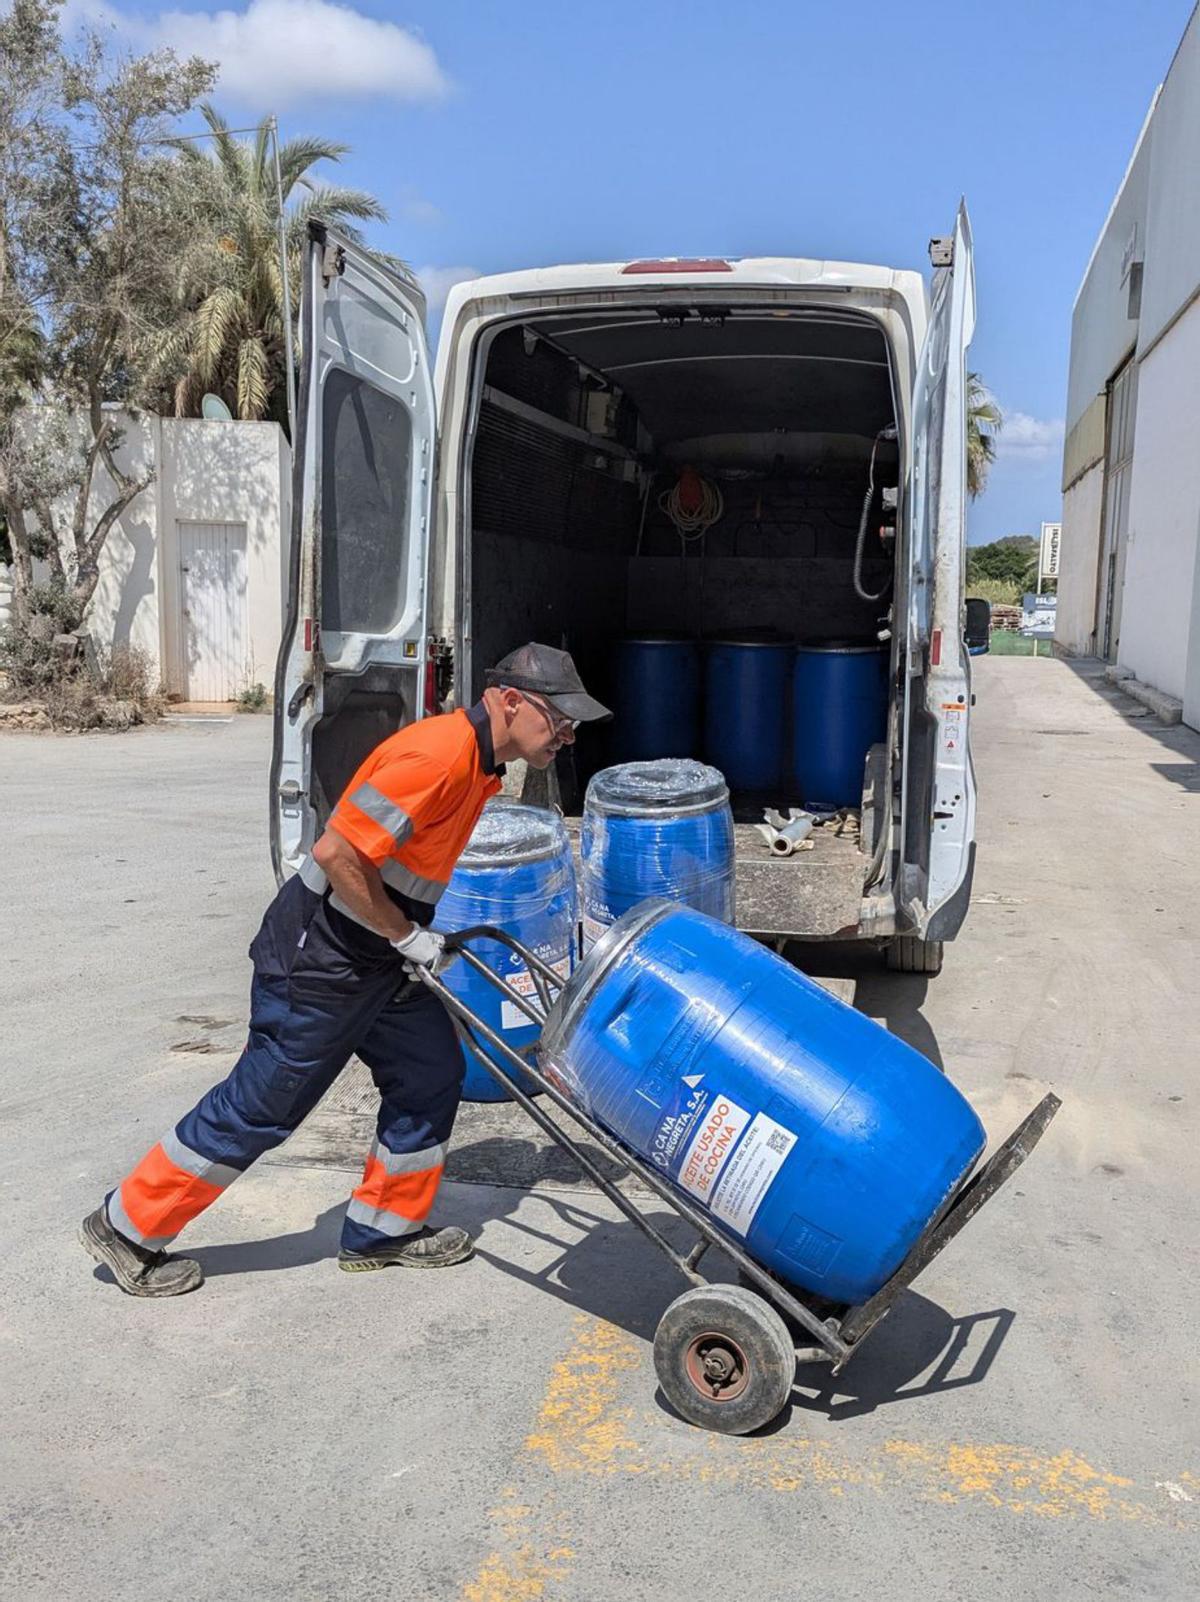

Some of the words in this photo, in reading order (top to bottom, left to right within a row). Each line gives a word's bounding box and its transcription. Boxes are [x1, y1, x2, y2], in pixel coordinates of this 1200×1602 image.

[510, 974, 530, 985] ACE
[654, 1132, 668, 1149] CA
[661, 1115, 676, 1134] NA
[663, 1108, 693, 1157] NEGRETA,
[686, 1086, 705, 1110] S.A.
[680, 1150, 704, 1188] ACEITE
[696, 1101, 731, 1152] USADO
[702, 1123, 736, 1175] COCINA
[695, 1173, 710, 1191] DE
